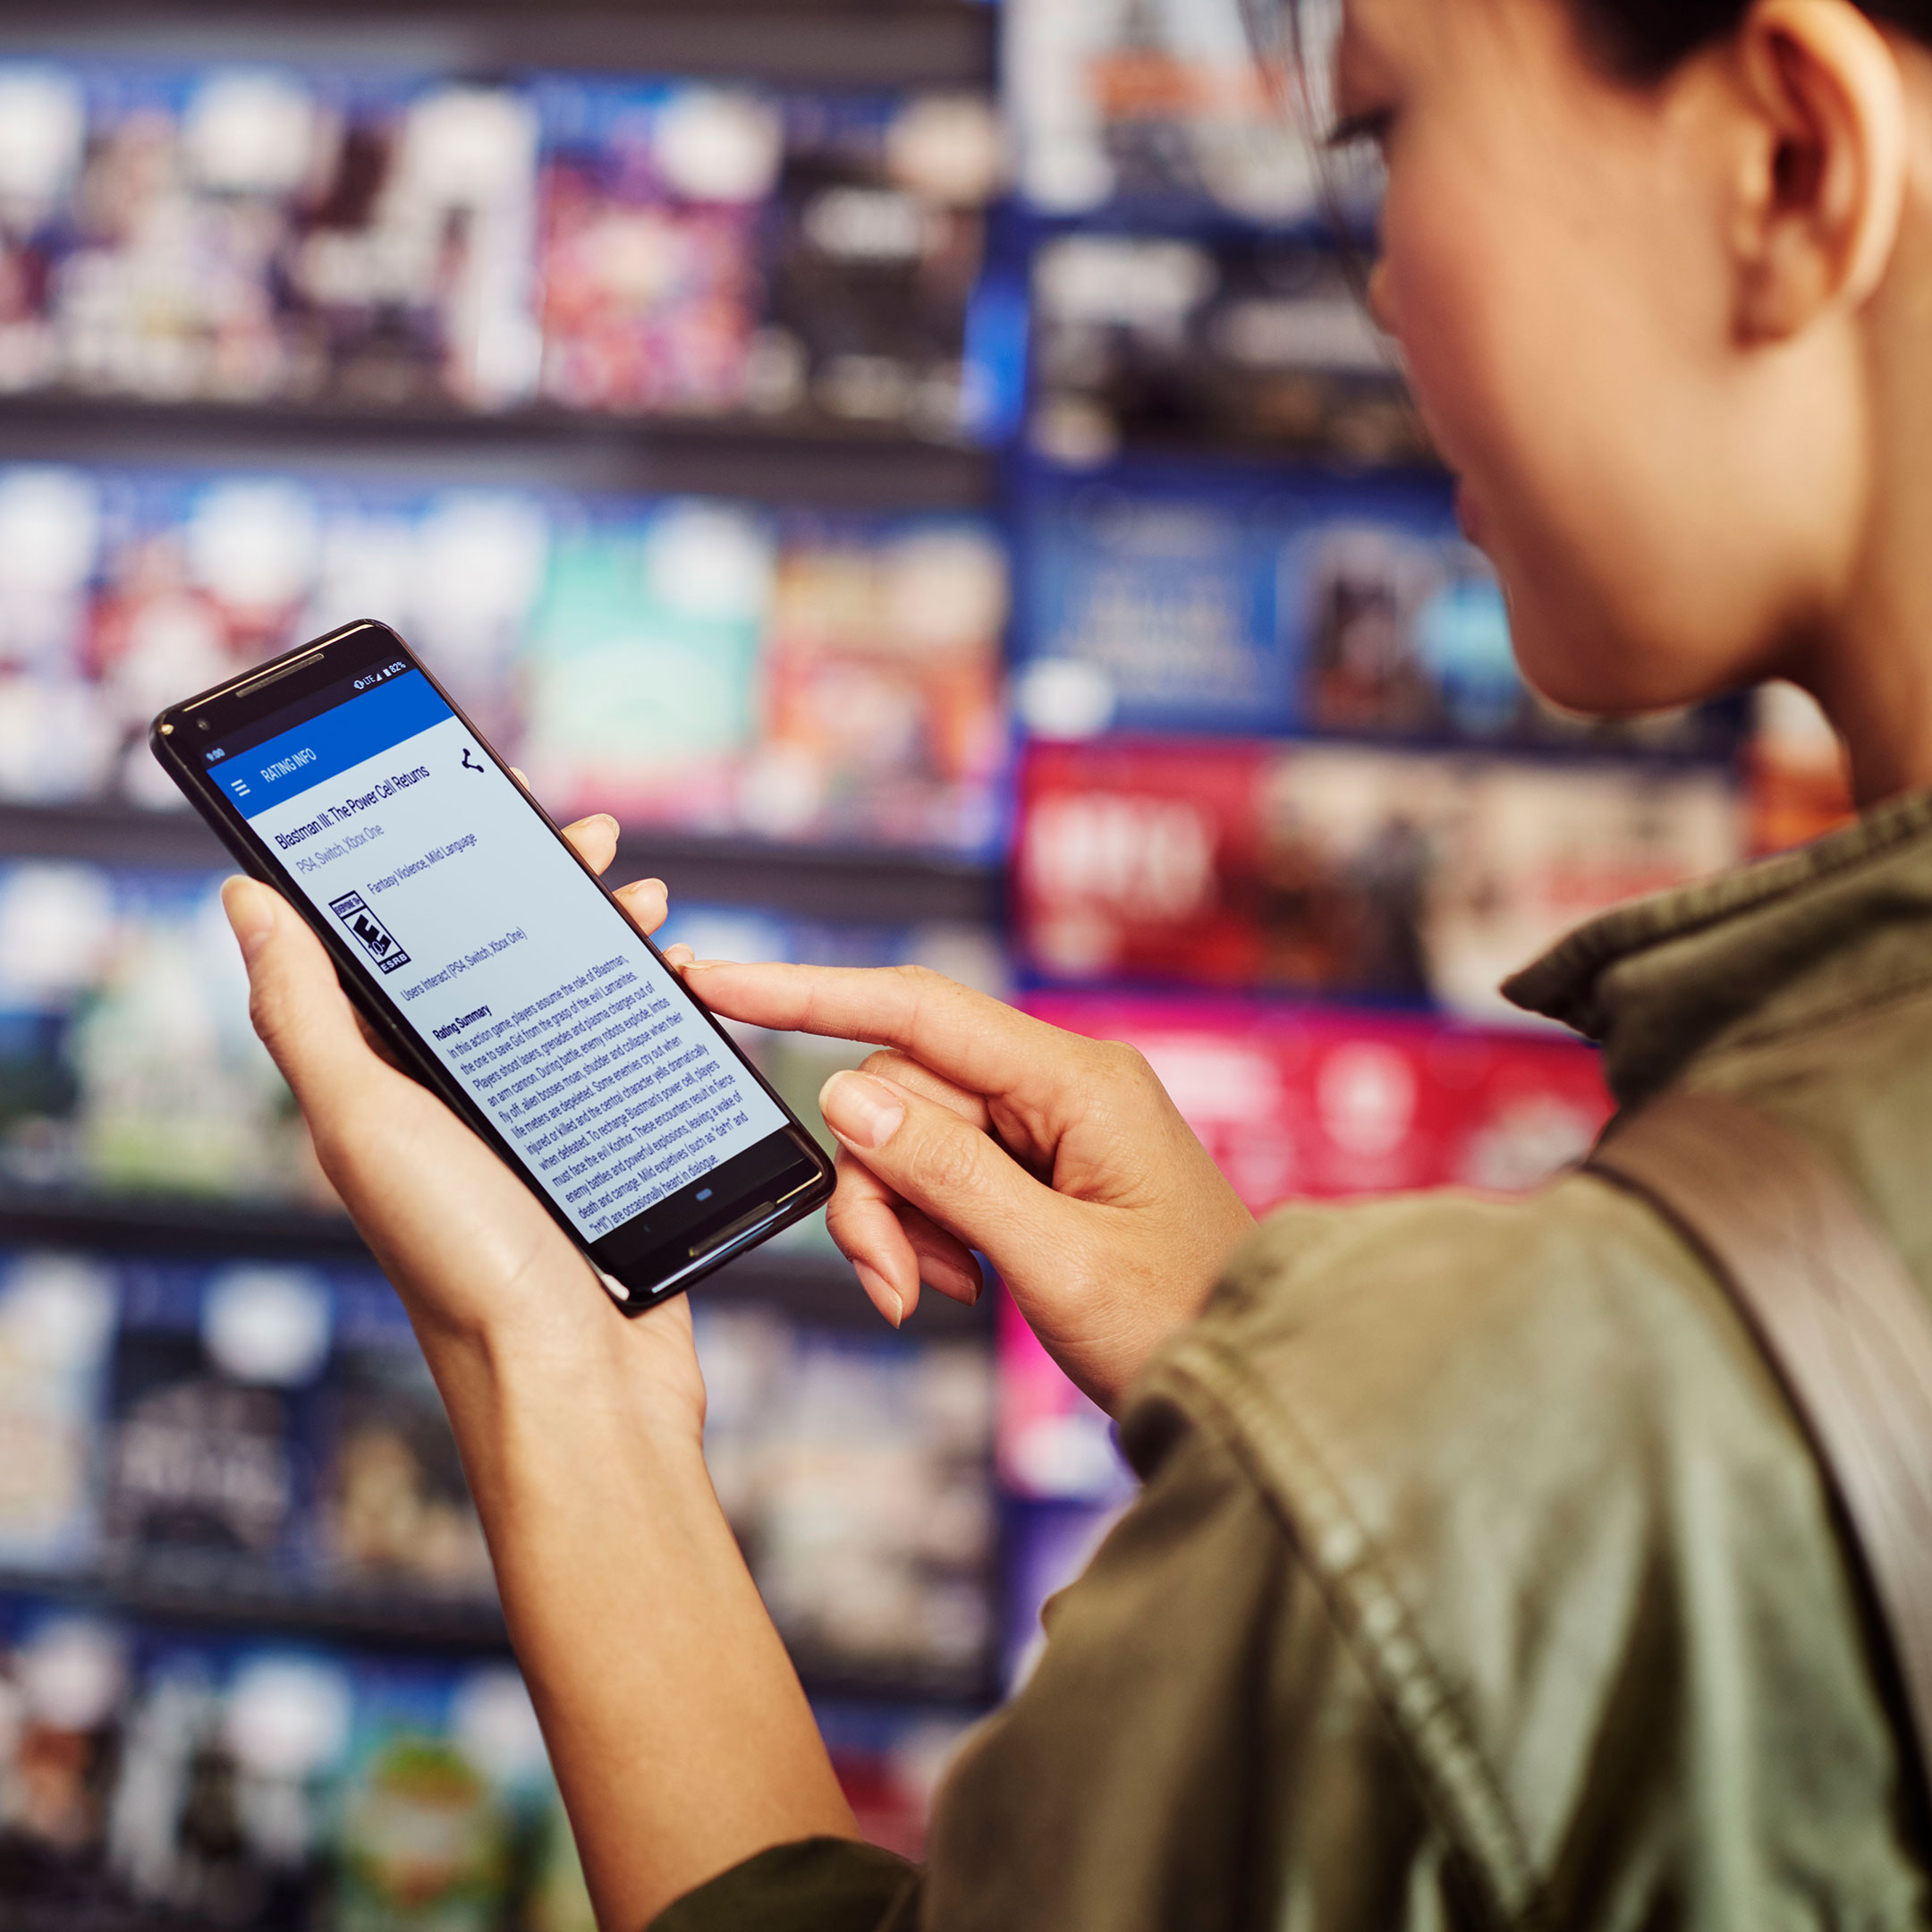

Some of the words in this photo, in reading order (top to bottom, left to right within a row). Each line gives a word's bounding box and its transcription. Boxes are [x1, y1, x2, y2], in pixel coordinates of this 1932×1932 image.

[362, 675, 376, 684] LTE
[389, 662, 406, 673] 82%
[260, 758, 296, 783] RATING
[292, 748, 317, 767] INFO
[275, 821, 323, 850] Blastman
[317, 813, 335, 828] III:
[327, 806, 352, 821] The
[346, 792, 378, 813] Power
[375, 779, 397, 798] Cell
[391, 767, 429, 790] Returns
[296, 857, 321, 874] PS4,
[315, 843, 349, 865] Switch,
[342, 834, 368, 851] Xbox
[363, 826, 384, 839] One
[367, 875, 399, 894] Fantasy
[394, 860, 430, 879] Violence,
[425, 848, 445, 864] Mild
[440, 834, 477, 856] Language
[379, 952, 409, 971] ESRB
[400, 985, 425, 1001] Users
[420, 970, 451, 990] Interact
[446, 960, 470, 979] (PS4,
[464, 947, 494, 966] Switch,
[488, 938, 510, 953] Xbox
[506, 928, 527, 944] One)
[446, 1049, 459, 1059] In
[454, 1041, 472, 1055] this
[470, 1030, 494, 1047] action
[491, 1019, 515, 1038] game,
[512, 1005, 538, 1026] players
[536, 990, 564, 1010] assume
[560, 984, 575, 996] the
[572, 976, 589, 989] role
[586, 970, 596, 981] of
[592, 955, 629, 978] Blastman,
[432, 1023, 461, 1041] Rating
[455, 1005, 492, 1029] Summary
[460, 1063, 476, 1075] the
[473, 1055, 489, 1068] one
[486, 1051, 497, 1061] to
[495, 1042, 513, 1056] save
[510, 1032, 526, 1046] Gid
[521, 1026, 542, 1040] from
[538, 1019, 554, 1030] the
[551, 1009, 572, 1027] grasp
[570, 1001, 580, 1013] of
[577, 997, 591, 1009] the
[589, 988, 603, 1003] evil
[599, 972, 638, 996] Lamanites.
[472, 1072, 502, 1091] Players
[499, 1059, 521, 1077] shoot
[516, 1048, 545, 1065] lasers,
[541, 1030, 573, 1055] grenades
[571, 1021, 587, 1036] and
[584, 1010, 611, 1030] plasma
[608, 996, 636, 1014] charges
[634, 987, 648, 1000] out
[645, 981, 655, 994] of
[487, 1096, 500, 1107] an
[496, 1088, 514, 1101] arm
[511, 1073, 540, 1093] cannon.
[536, 1060, 564, 1078] During
[557, 1048, 584, 1065] battle,
[580, 1036, 606, 1054] enemy
[602, 1024, 625, 1041] robots
[623, 1009, 654, 1029] explode,
[648, 998, 670, 1013] limbs
[498, 1111, 513, 1123] fly
[510, 1103, 526, 1117] off,
[521, 1096, 541, 1111] alien
[536, 1081, 564, 1101] bosses
[562, 1071, 587, 1087] moan,
[583, 1055, 611, 1075] shudder
[609, 1045, 625, 1060] and
[623, 1031, 651, 1052] collapse
[649, 1021, 669, 1036] when
[665, 1012, 682, 1026] their
[511, 1125, 528, 1140] life
[524, 1114, 551, 1132] meters
[548, 1106, 563, 1119] are
[560, 1085, 596, 1112] depeleted.
[592, 1076, 615, 1092] Some
[614, 1060, 642, 1080] enemies
[640, 1054, 655, 1064] cry
[651, 1046, 665, 1058] out
[662, 1037, 682, 1052] when
[524, 1133, 552, 1155] injured
[549, 1131, 559, 1141] or
[555, 1118, 578, 1137] killed
[575, 1110, 591, 1126] and
[587, 1106, 603, 1118] the
[600, 1091, 624, 1112] central
[623, 1075, 655, 1098] character
[652, 1066, 670, 1083] yells
[668, 1044, 709, 1072] dramatically
[538, 1155, 561, 1171] when
[557, 1134, 591, 1160] defeated.
[586, 1131, 600, 1141] To
[597, 1114, 629, 1136] recharge
[661, 1081, 682, 1101] power
[682, 1072, 699, 1087] cell,
[694, 1061, 720, 1081] players
[552, 1170, 573, 1187] must
[568, 1162, 588, 1176] face
[583, 1156, 599, 1167] the
[597, 1145, 611, 1160] evil
[606, 1133, 637, 1153] Korihor.
[631, 1122, 657, 1138] These
[655, 1100, 692, 1126] encounters
[690, 1088, 710, 1106] result
[706, 1085, 717, 1094] in
[713, 1075, 735, 1089] fierce
[565, 1183, 591, 1203] enemy
[585, 1171, 614, 1190] battles
[611, 1160, 627, 1176] and
[623, 1143, 655, 1171] powerful
[652, 1125, 691, 1151] explosions,
[685, 1111, 715, 1130] leaving
[711, 1108, 718, 1116] a
[716, 1097, 735, 1113] wake
[733, 1089, 742, 1102] of
[578, 1200, 600, 1219] death
[597, 1191, 614, 1208] and
[611, 1178, 642, 1199] carnage.
[637, 1165, 657, 1182] Mild
[655, 1149, 689, 1174] expletives
[684, 1137, 708, 1156] (such
[705, 1132, 716, 1143] as
[733, 1111, 749, 1126] and
[611, 1211, 625, 1224] are
[623, 1186, 665, 1216] occasionally
[659, 1174, 683, 1192] heard
[679, 1171, 691, 1181] in
[688, 1155, 719, 1176] dialogue.
